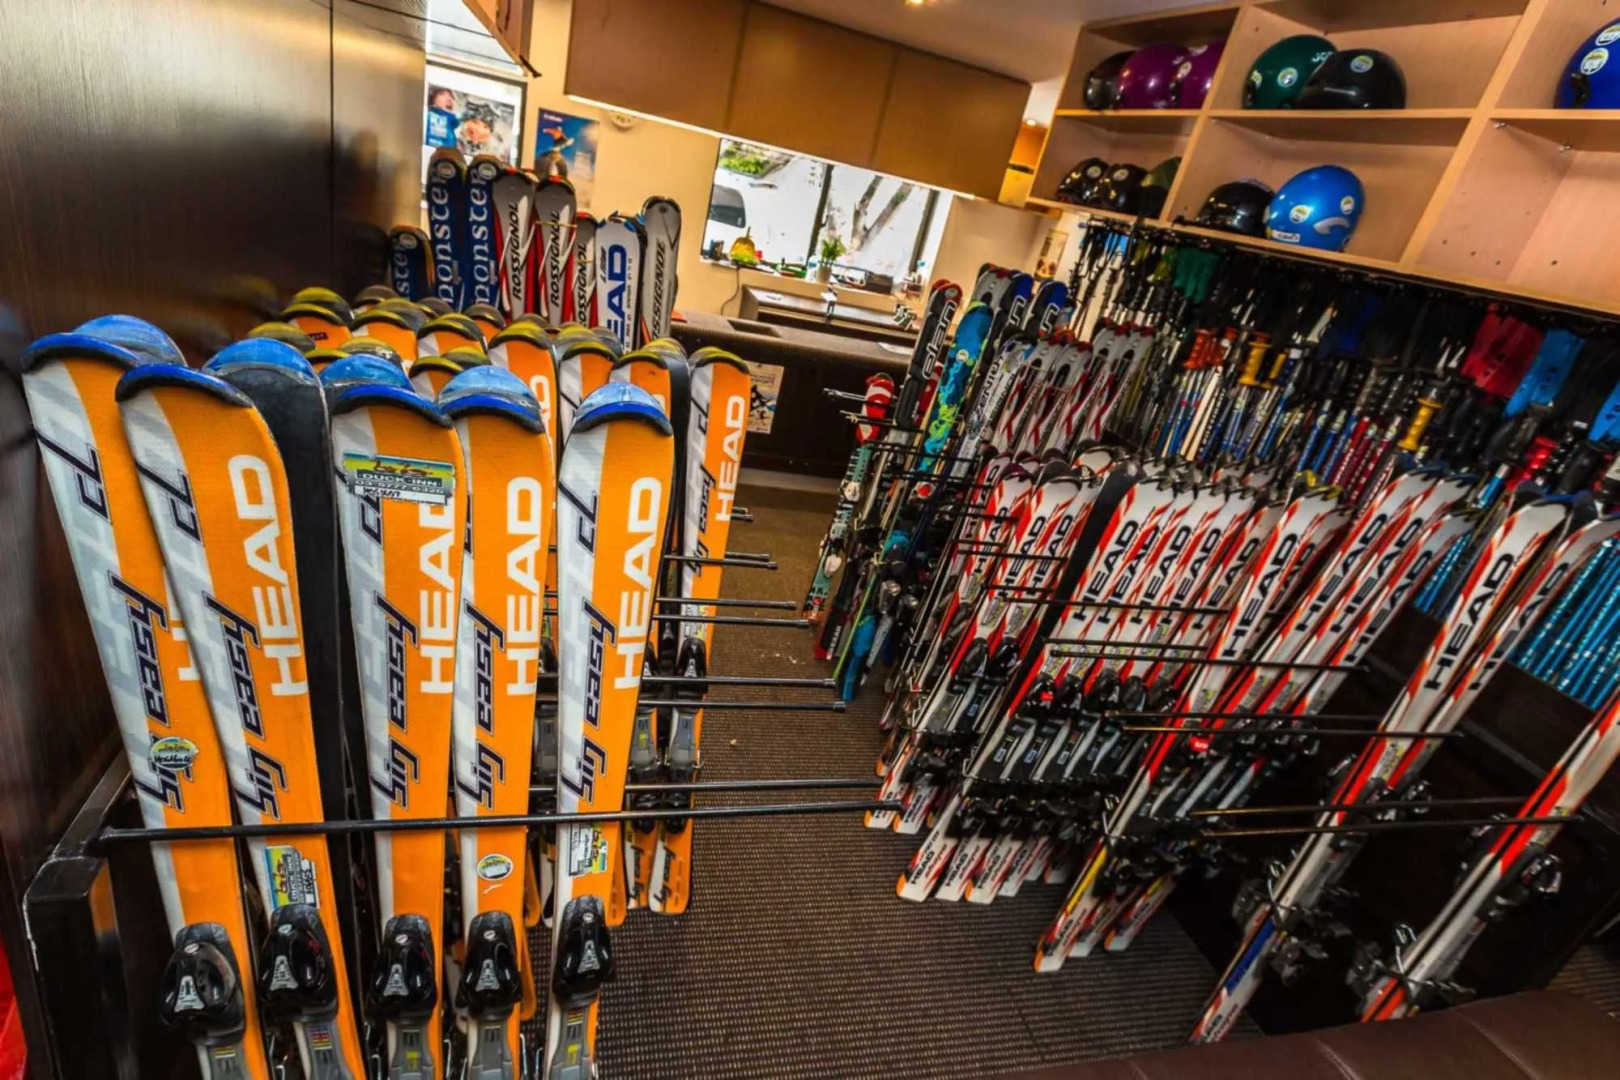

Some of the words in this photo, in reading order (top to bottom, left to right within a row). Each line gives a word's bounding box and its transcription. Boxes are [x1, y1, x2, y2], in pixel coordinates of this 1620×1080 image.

[510, 202, 522, 301] ROSSIGNOL
[549, 211, 560, 308] ROSSIGNOL
[607, 244, 627, 340] EAD
[363, 472, 407, 484] DUCK
[411, 478, 438, 488] INN
[699, 464, 717, 545] easy
[715, 394, 746, 522] HEAD
[228, 454, 309, 697] HEAD
[506, 476, 543, 696] HEAD
[613, 476, 662, 690] HEAD
[1072, 520, 1139, 622] HEAD
[1097, 525, 1160, 624] HEAD
[1130, 525, 1191, 625] HEAD
[1160, 528, 1222, 625] HEAD
[1192, 538, 1260, 630] HEAD
[1221, 533, 1298, 657] HEAD
[1295, 513, 1387, 632] HEAD
[1330, 518, 1423, 633] HEAD
[1344, 550, 1433, 662] HEAD
[1424, 553, 1514, 691] HEAD
[107, 570, 171, 728] easy
[202, 590, 265, 740] easy
[374, 590, 418, 734] easy
[463, 598, 505, 736] easy
[582, 596, 617, 731] easy
[1467, 562, 1570, 690] HEAD
[234, 742, 289, 822] big
[370, 738, 421, 811] big
[455, 739, 506, 812] big
[560, 735, 607, 805] big
[910, 850, 935, 886] HEAD
